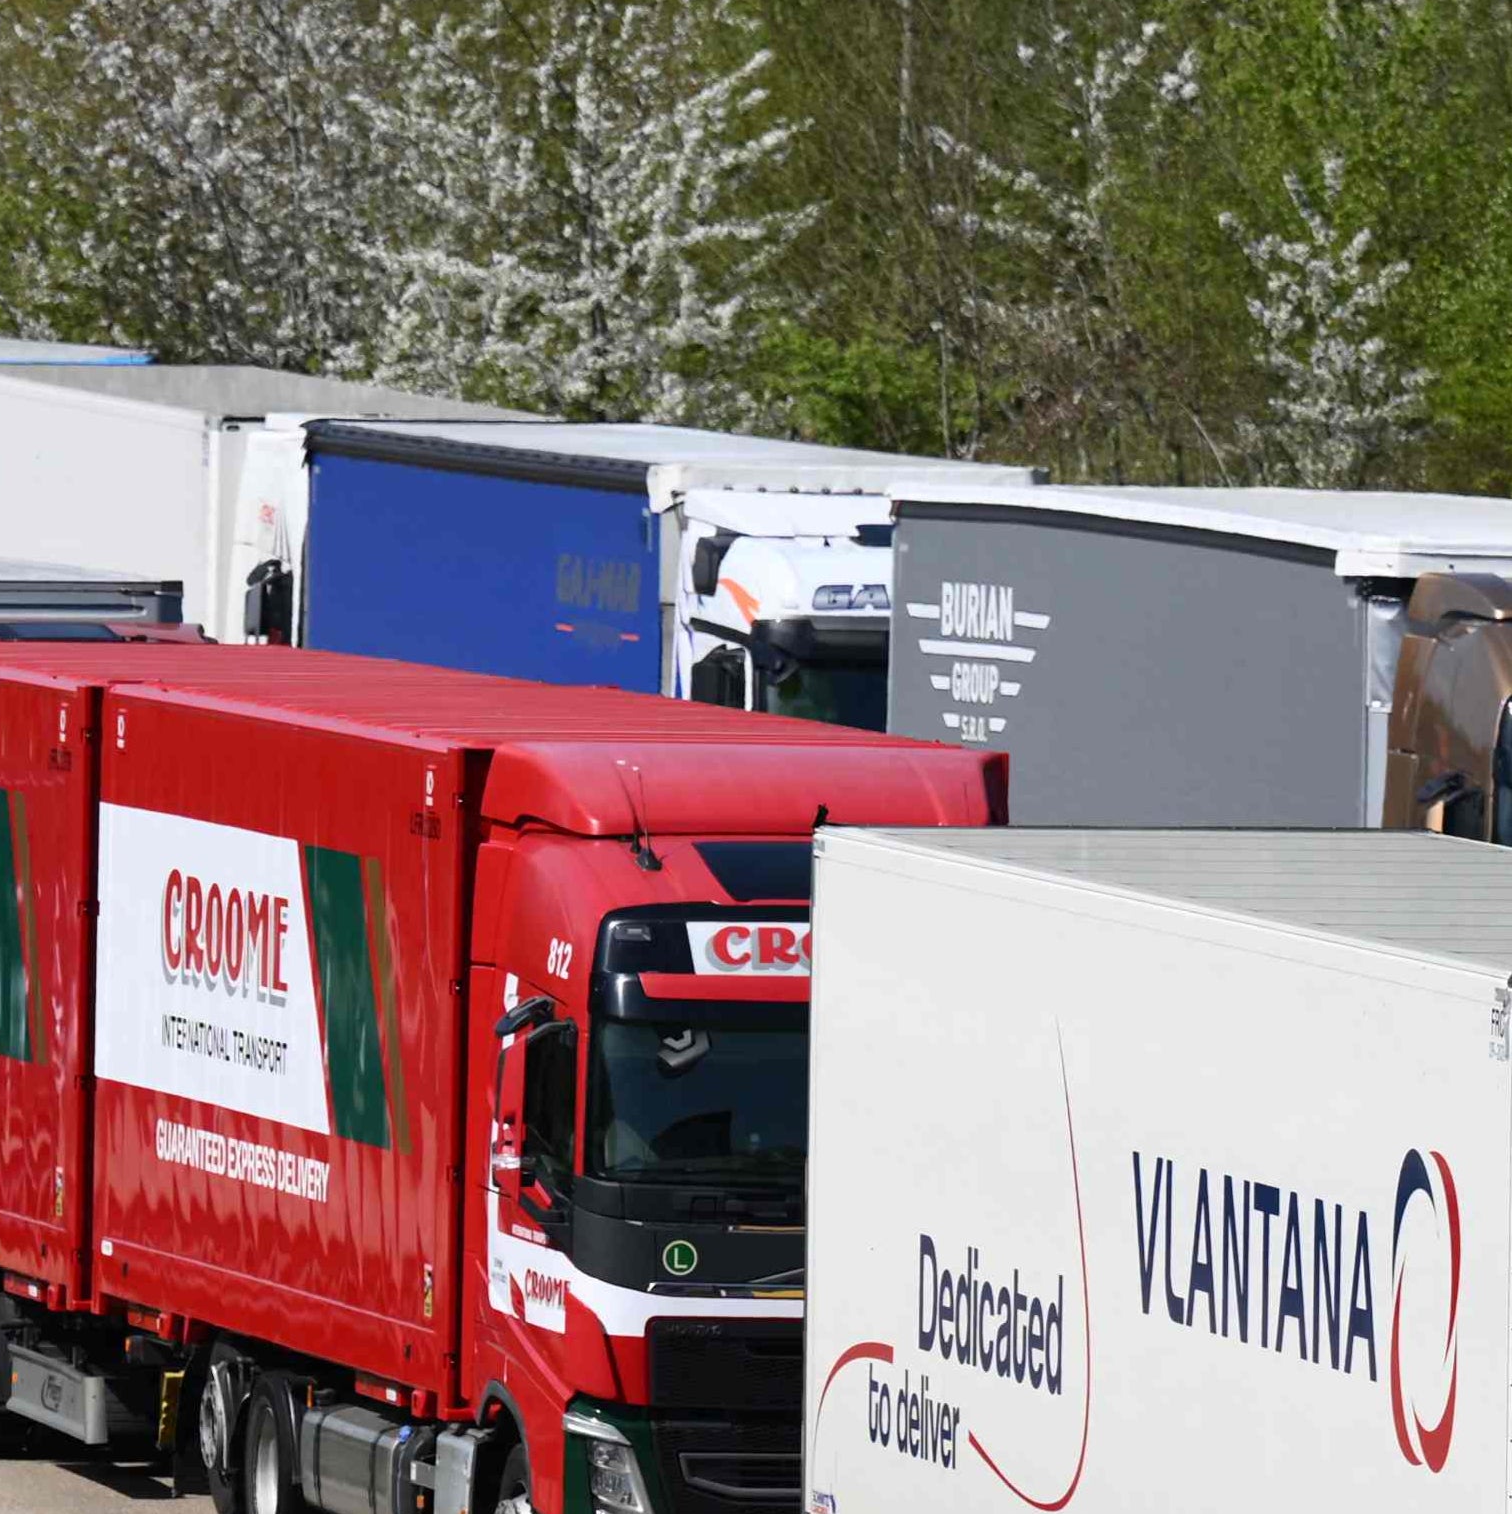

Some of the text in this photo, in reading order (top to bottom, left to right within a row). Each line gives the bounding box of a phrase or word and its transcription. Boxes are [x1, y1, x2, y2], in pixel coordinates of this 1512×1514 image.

[941, 581, 1013, 641] BURIAN
[951, 662, 1000, 704] GROUP
[162, 868, 289, 1002] CROOME
[547, 937, 573, 980] 812
[161, 1013, 288, 1075] INTERNATIONAL TRANSPORT
[156, 1118, 331, 1204] GUARANTEED EXPRESS DELIVERY
[674, 1247, 688, 1269] L
[1132, 1150, 1378, 1383] VLANTANA
[918, 1233, 1064, 1396] Dedicated
[869, 1362, 960, 1470] to deliver
